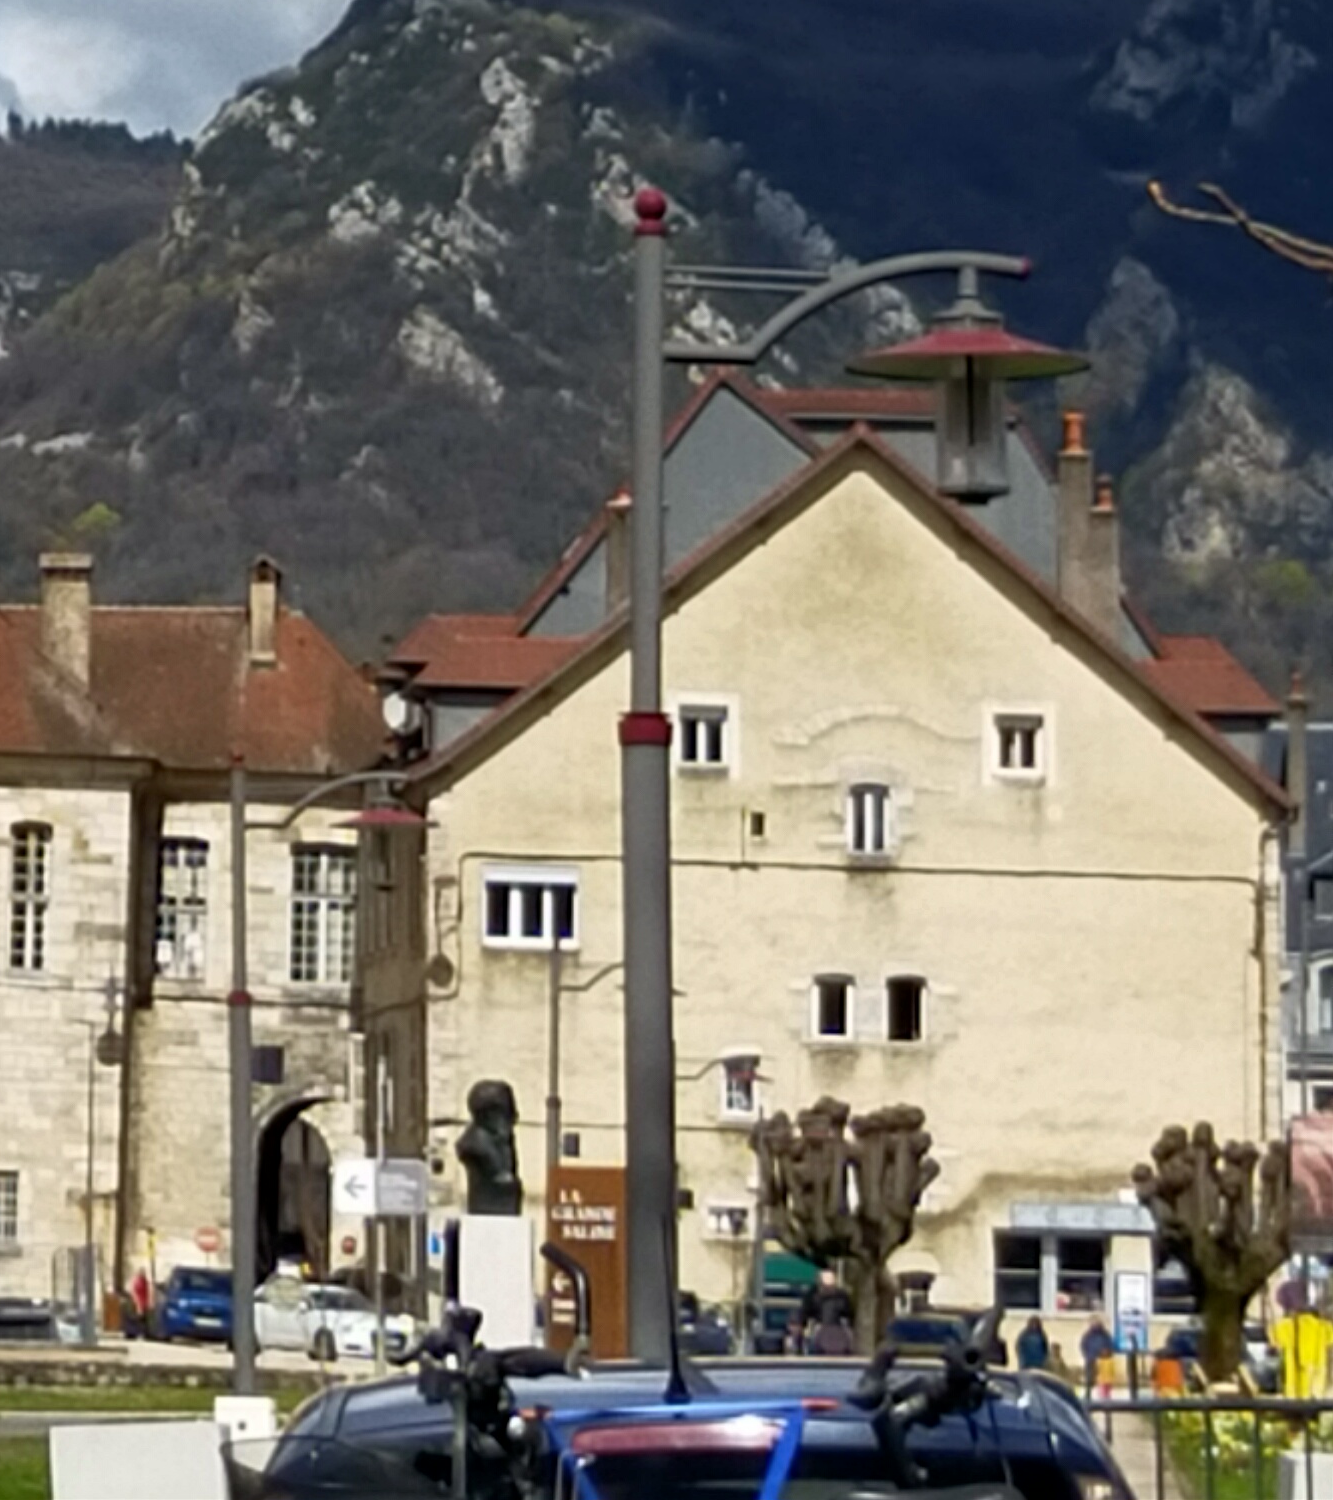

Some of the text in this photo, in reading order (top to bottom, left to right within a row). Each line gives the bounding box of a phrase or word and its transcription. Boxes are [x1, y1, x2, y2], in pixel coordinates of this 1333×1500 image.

[559, 1189, 582, 1204] LA
[551, 1205, 617, 1221] GRANDE
[562, 1224, 617, 1241] SALINE
